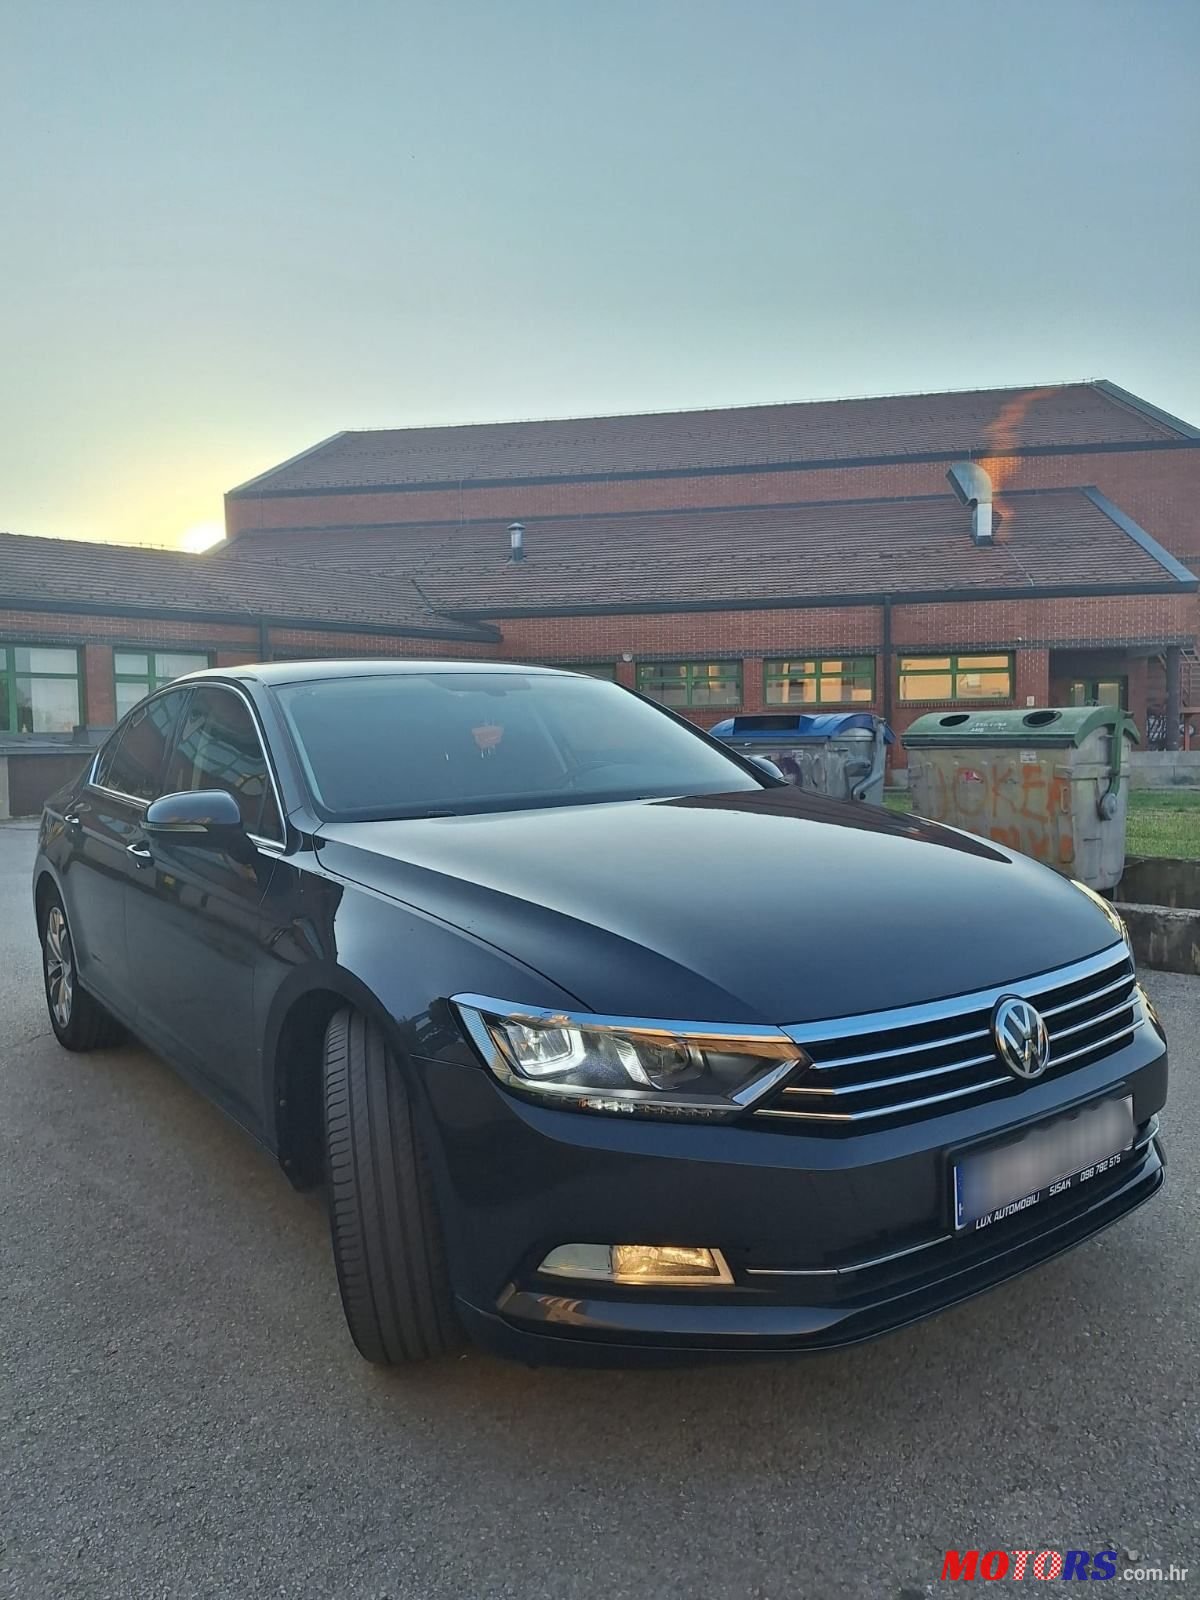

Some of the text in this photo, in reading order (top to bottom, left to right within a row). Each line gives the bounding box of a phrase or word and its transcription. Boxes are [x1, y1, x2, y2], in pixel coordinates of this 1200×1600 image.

[976, 1213, 993, 1230] LUX
[993, 1192, 1040, 1222] AUTOMOBILI
[1048, 1178, 1071, 1197] SISAK
[1109, 1153, 1121, 1168] 575
